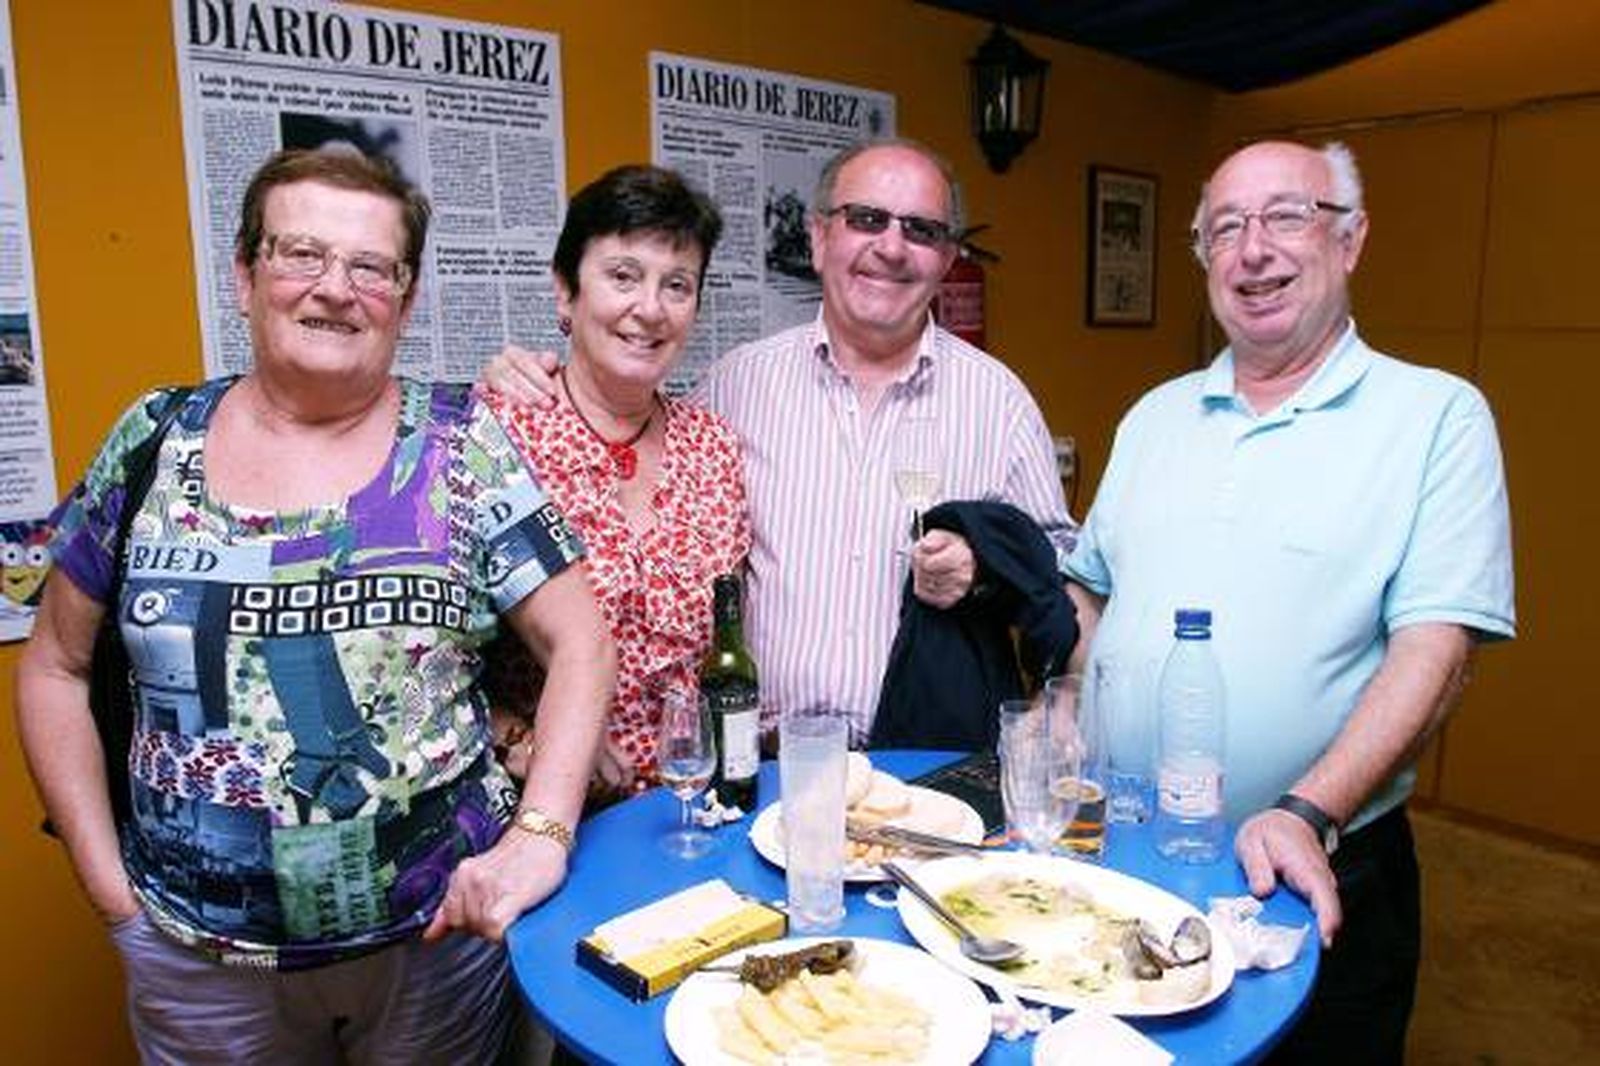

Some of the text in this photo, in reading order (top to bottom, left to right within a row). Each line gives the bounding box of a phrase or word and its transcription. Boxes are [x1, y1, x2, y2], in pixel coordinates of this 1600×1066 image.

[188, 0, 550, 86] DIARIO DE JEREZ
[656, 63, 861, 128] DIARIO DE JEREZ
